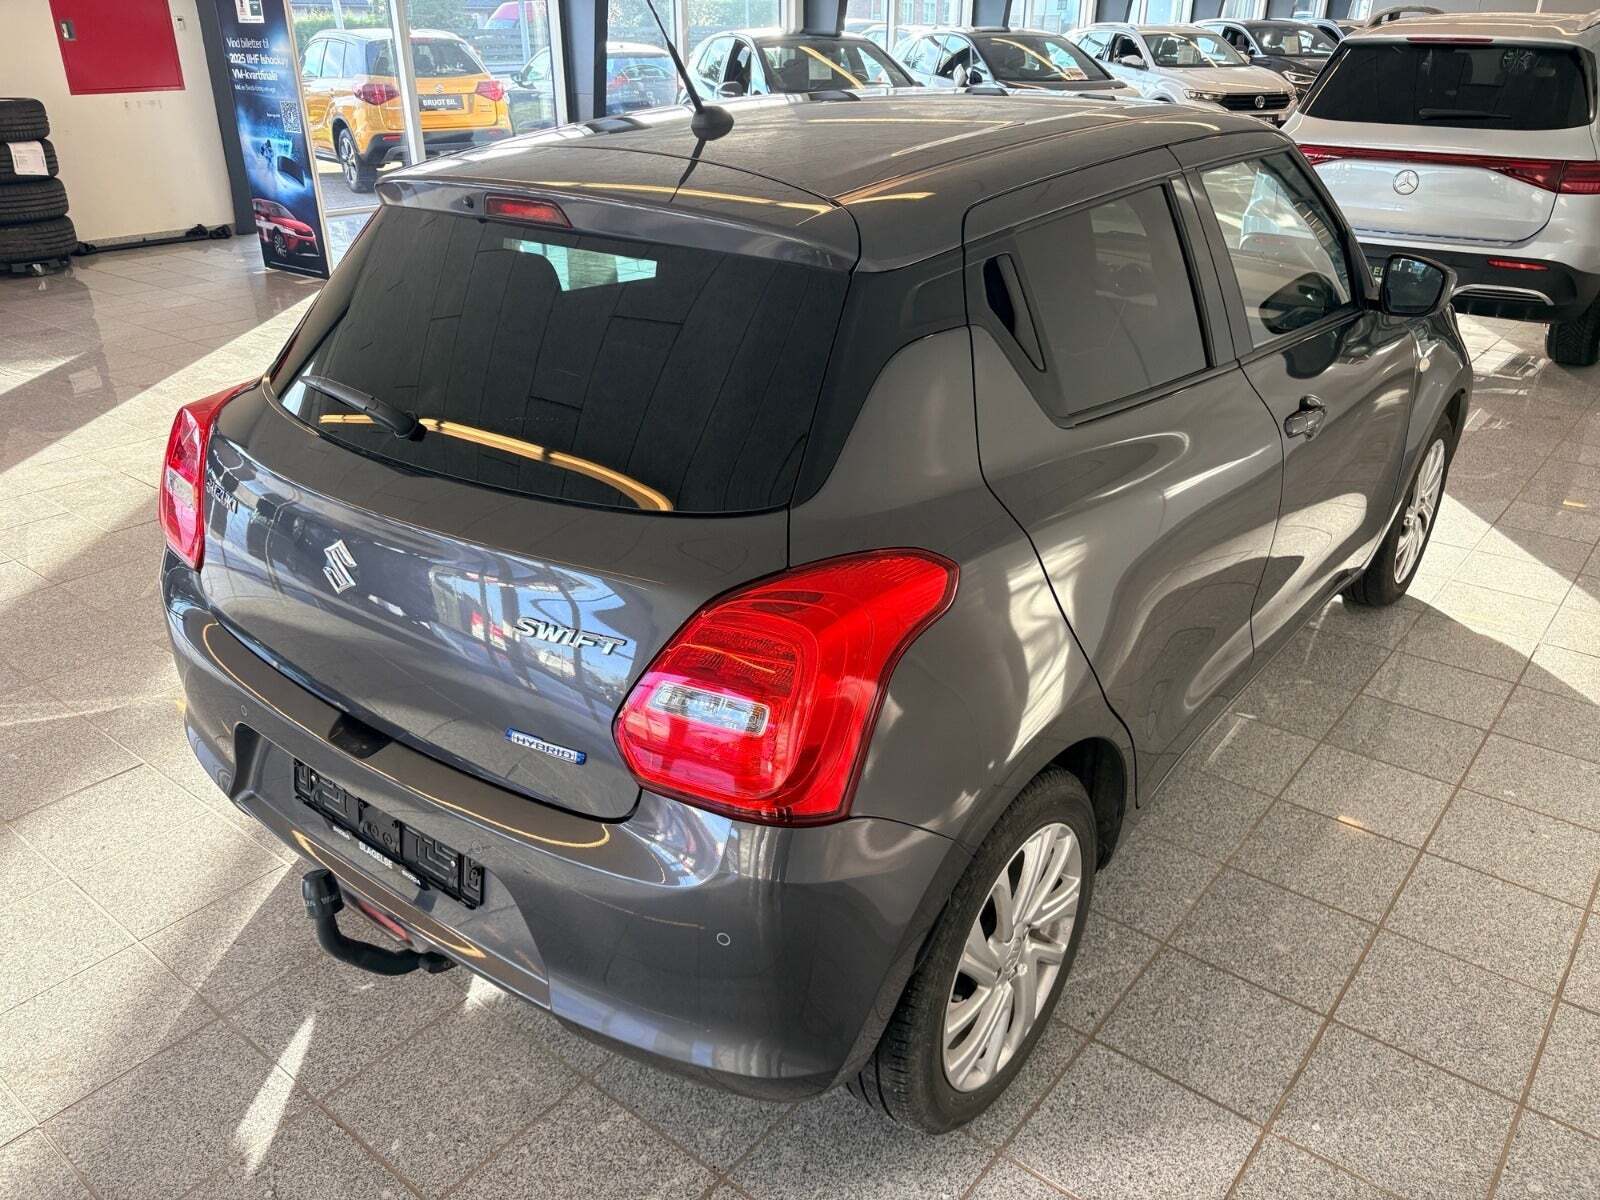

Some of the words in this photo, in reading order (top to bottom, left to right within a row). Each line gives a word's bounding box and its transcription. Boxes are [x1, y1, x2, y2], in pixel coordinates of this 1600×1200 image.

[229, 53, 246, 64] 2025
[422, 99, 447, 108] BRUGT
[206, 478, 239, 514] SUZUKI
[513, 617, 627, 655] SWIFT
[513, 734, 574, 760] HYBRID
